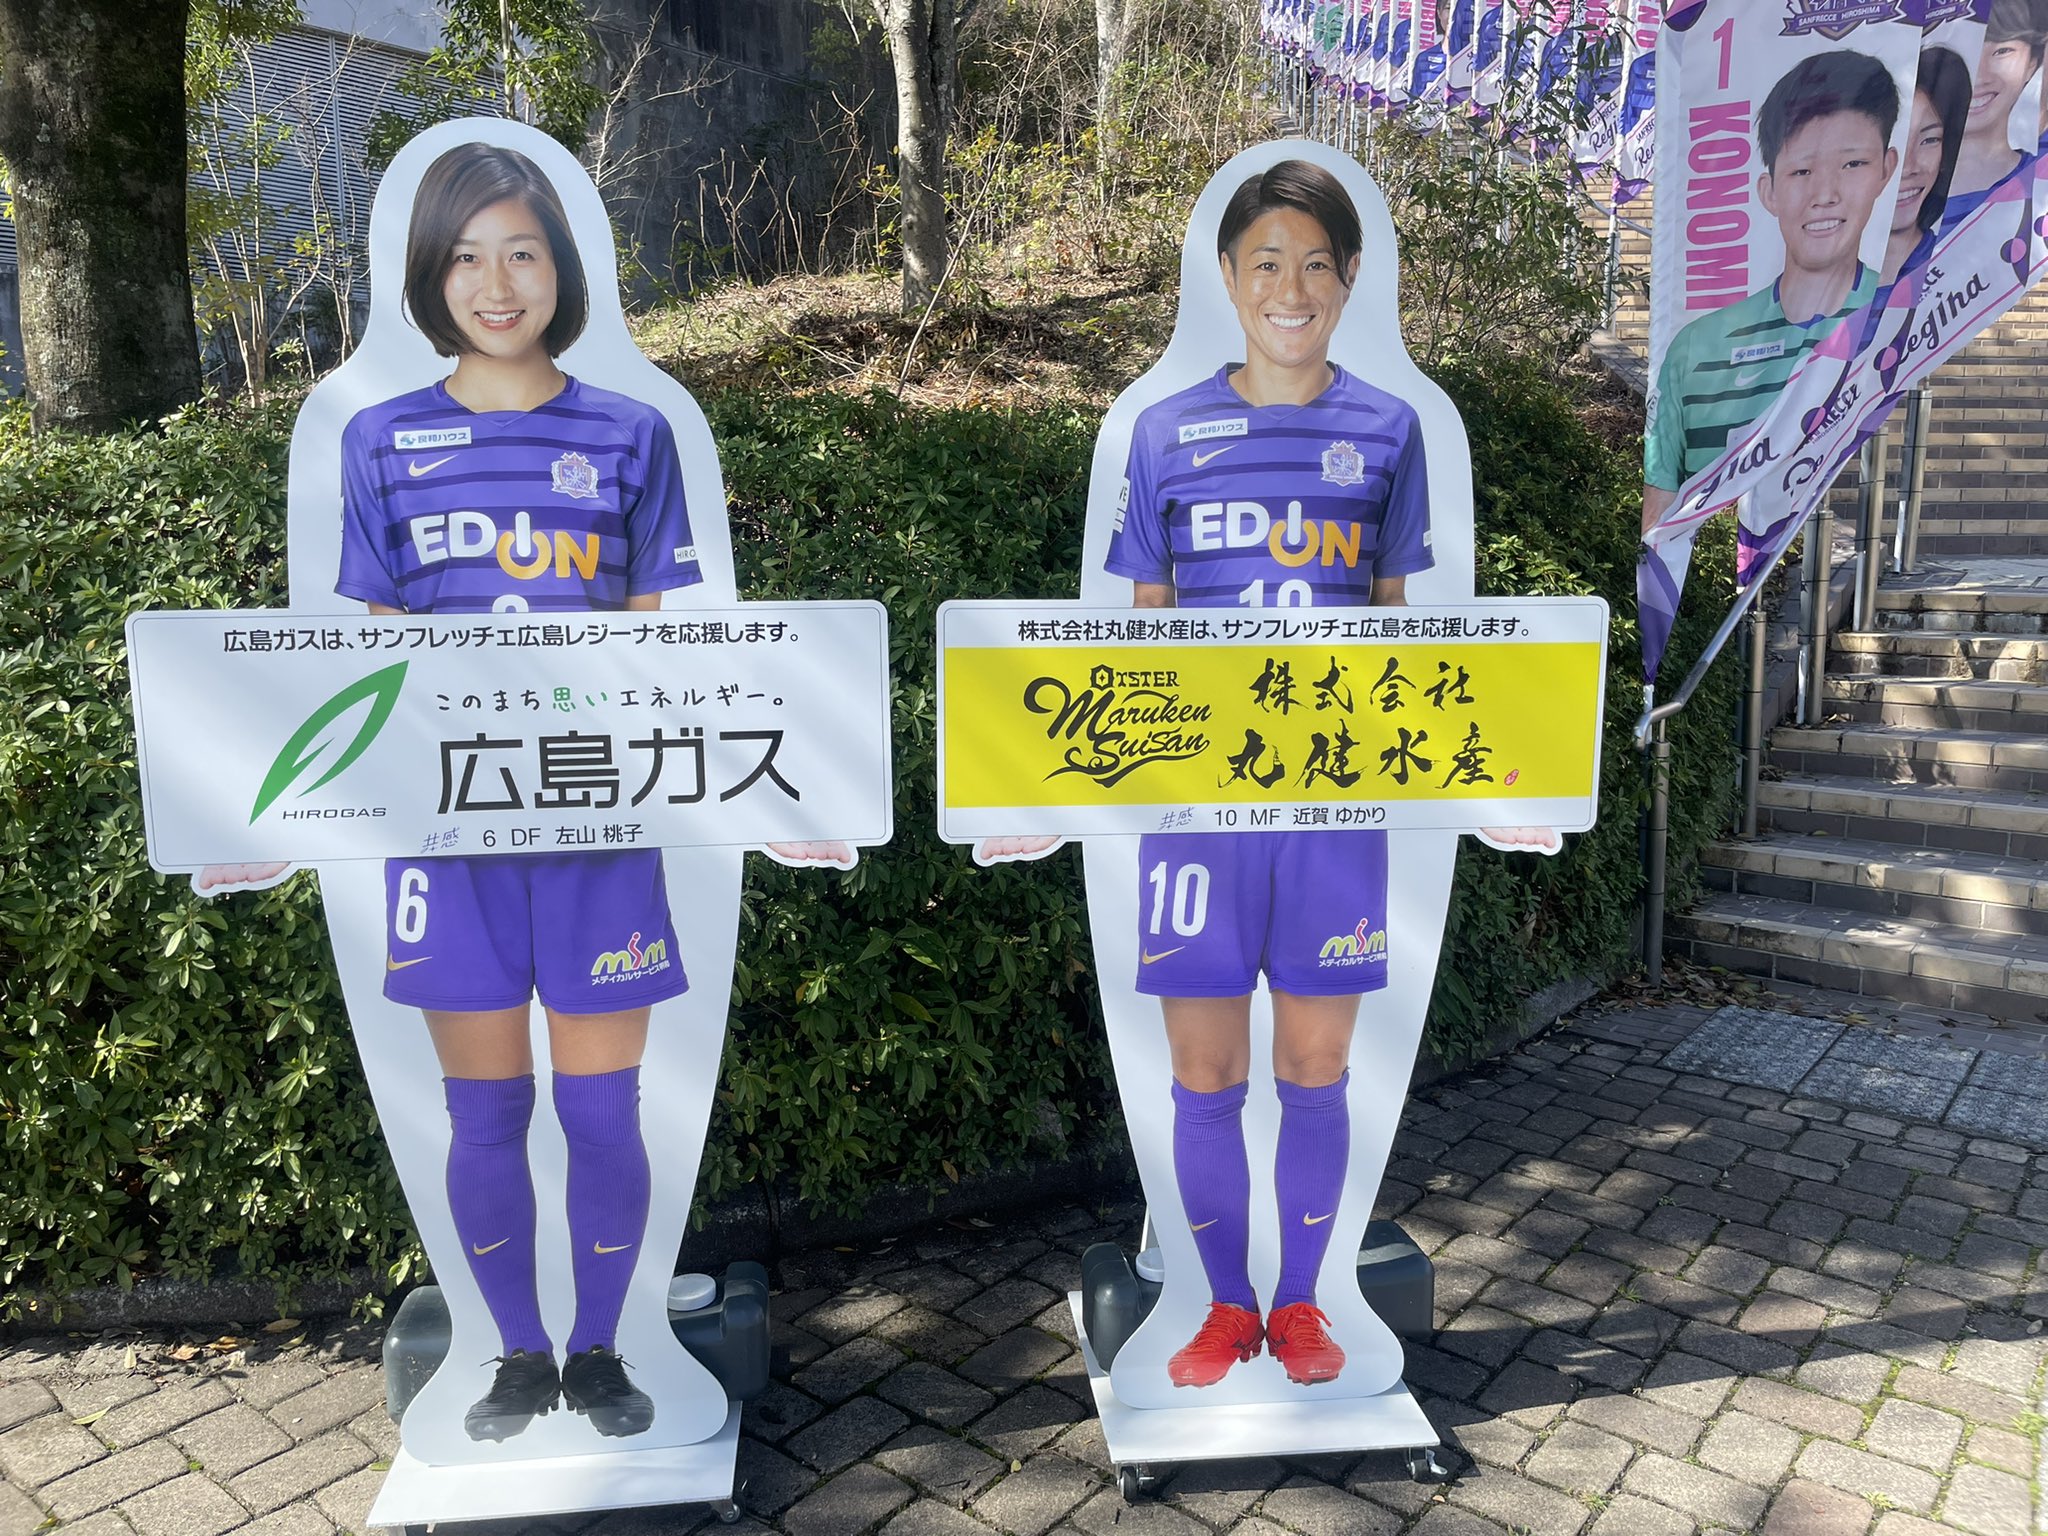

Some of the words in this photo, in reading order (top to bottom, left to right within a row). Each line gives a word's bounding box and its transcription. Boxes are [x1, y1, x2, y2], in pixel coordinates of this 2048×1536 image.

[1798, 14, 1837, 27] SANFRECCE
[1841, 5, 1881, 20] HIROSHIMA
[1713, 18, 1735, 89] 1
[1686, 100, 1751, 310] KONOMI
[1899, 272, 1991, 365] egina
[223, 621, 800, 653] 広島ガスは、サンフレッチェ広島レジーナを応援します。
[1018, 616, 1530, 642] 株式会社丸健水産は、サンフレッチェ広島を応援します。
[437, 683, 785, 713] このまち思いエネルギー。
[1023, 677, 1212, 741] Maruken
[1248, 656, 1475, 716] 株式会社
[437, 727, 801, 815] 広島ガス
[1042, 726, 1211, 788] Suisan
[1217, 718, 1494, 790] 丸健水産
[282, 807, 387, 821] HIROGAS
[483, 829, 497, 847] 6
[511, 827, 542, 846] DF
[555, 826, 596, 845] 左山
[602, 823, 643, 844] 桃子
[1214, 809, 1238, 827] 10
[1250, 808, 1281, 826] MF
[1293, 807, 1329, 826] 近賀
[1335, 806, 1387, 825] ゆかり
[395, 867, 430, 943] 6
[1150, 861, 1211, 937] 10
